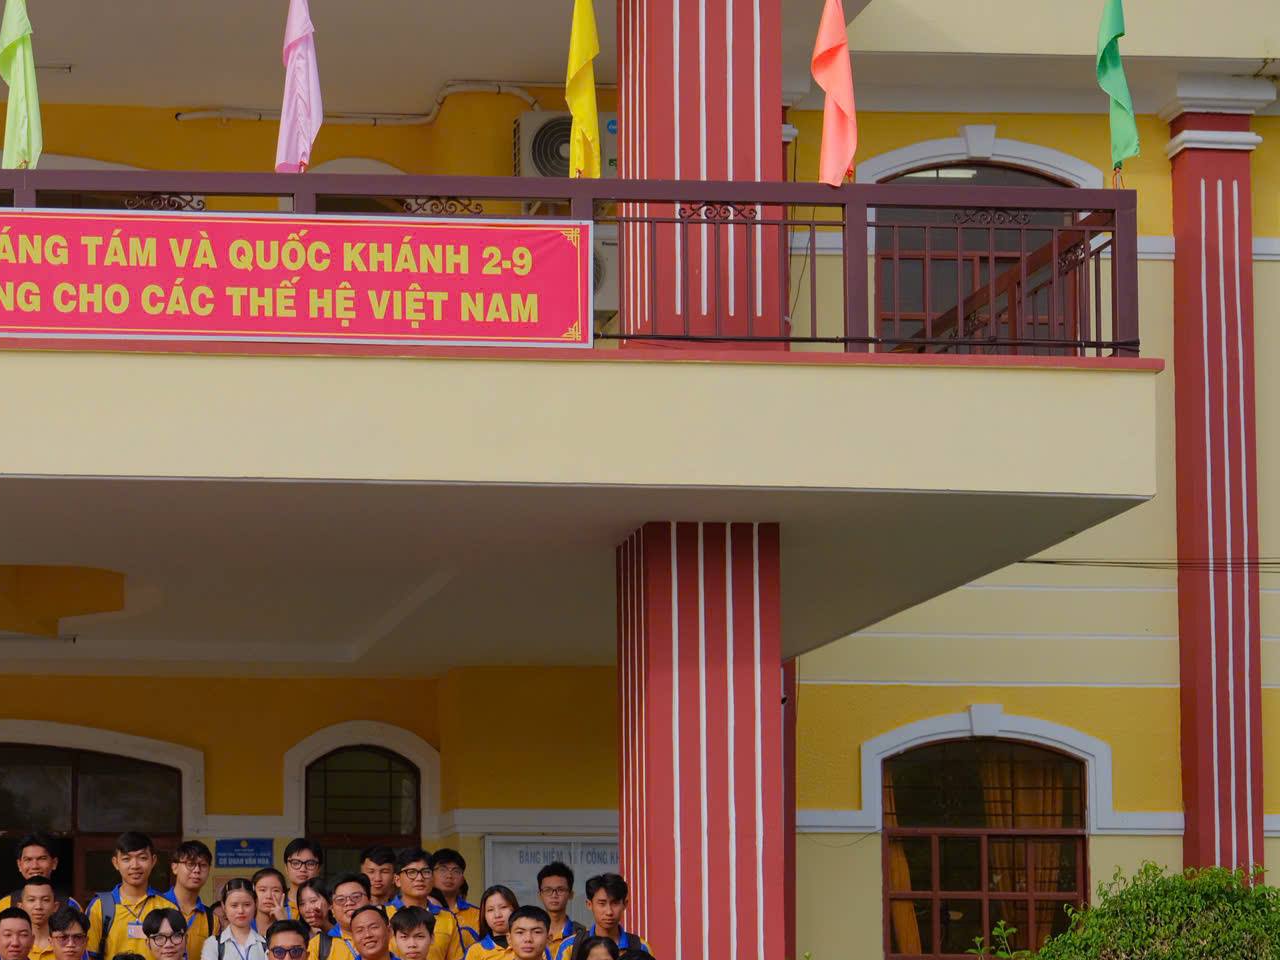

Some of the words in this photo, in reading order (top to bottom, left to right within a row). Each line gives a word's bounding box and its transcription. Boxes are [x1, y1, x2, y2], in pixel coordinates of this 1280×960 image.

[81, 229, 156, 266] TÁM
[172, 231, 217, 268] VÀ
[229, 230, 330, 271] QUỐC
[344, 236, 468, 273] KHÁNH
[482, 246, 532, 275] 2-9
[53, 283, 129, 313] CHO
[142, 279, 214, 315] CÁC
[226, 277, 297, 317] THẾ
[310, 282, 355, 327] HỆ
[368, 283, 448, 328] VIỆT
[461, 293, 538, 322] NAM
